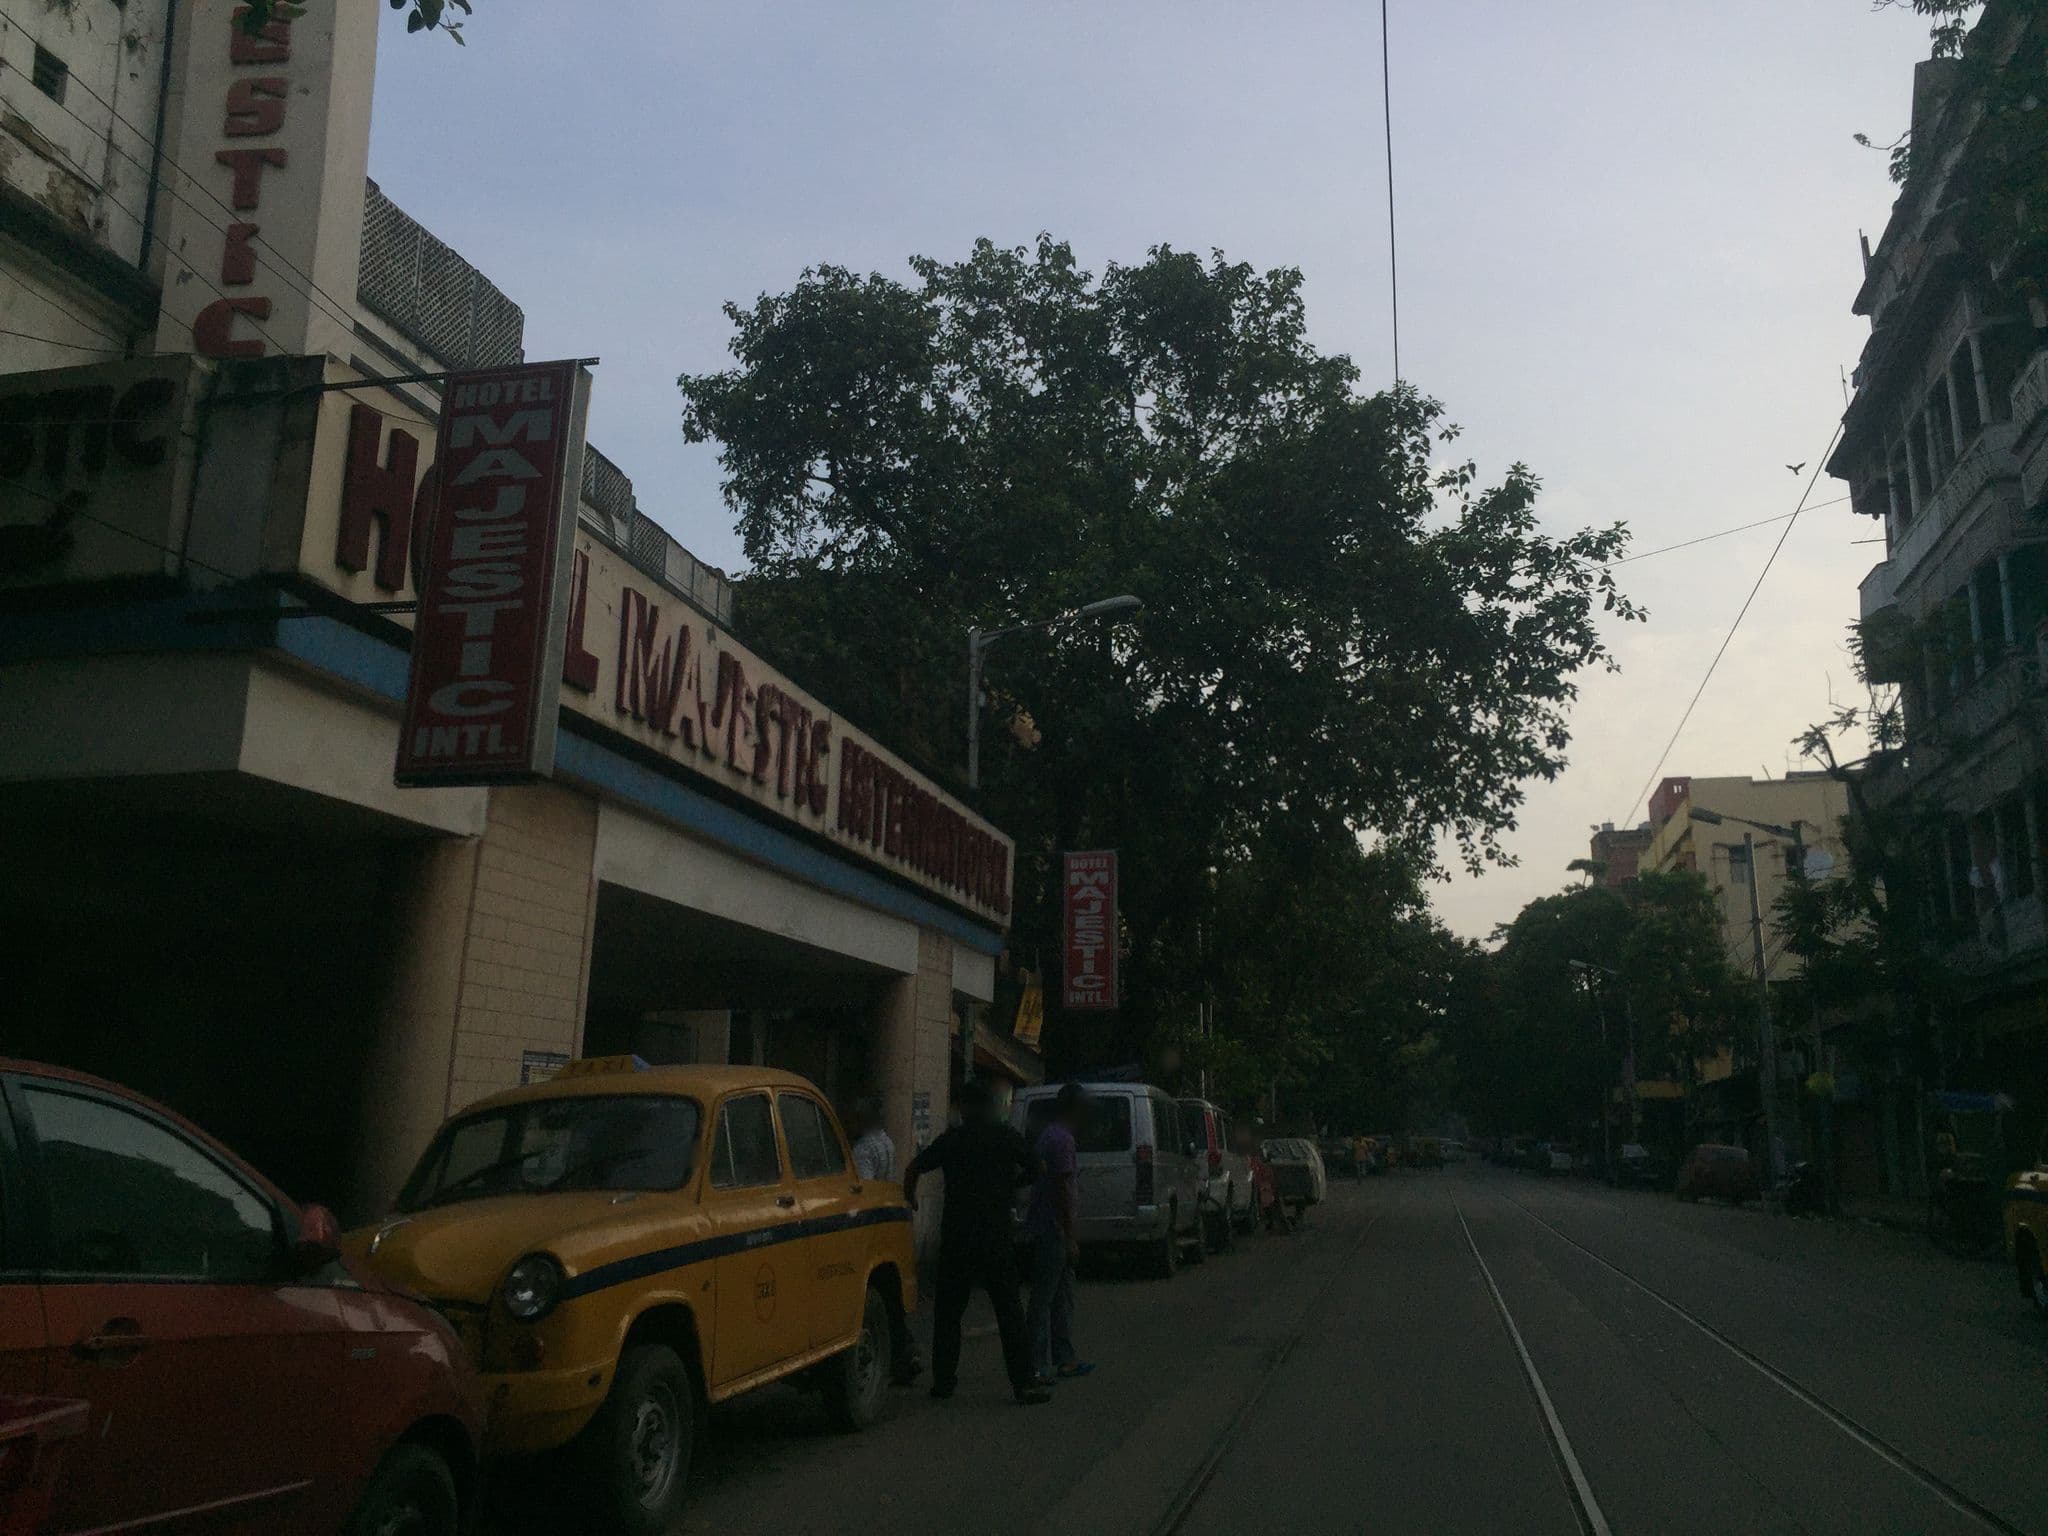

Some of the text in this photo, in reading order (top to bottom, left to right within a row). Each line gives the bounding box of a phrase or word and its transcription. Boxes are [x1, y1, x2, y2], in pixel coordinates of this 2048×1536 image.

[455, 375, 555, 409] HOTEL
[428, 408, 555, 718] MAJESTIC
[413, 723, 519, 761] INTL.
[616, 586, 832, 818] MAJESTIC
[1069, 871, 1109, 989] MAJESTIC
